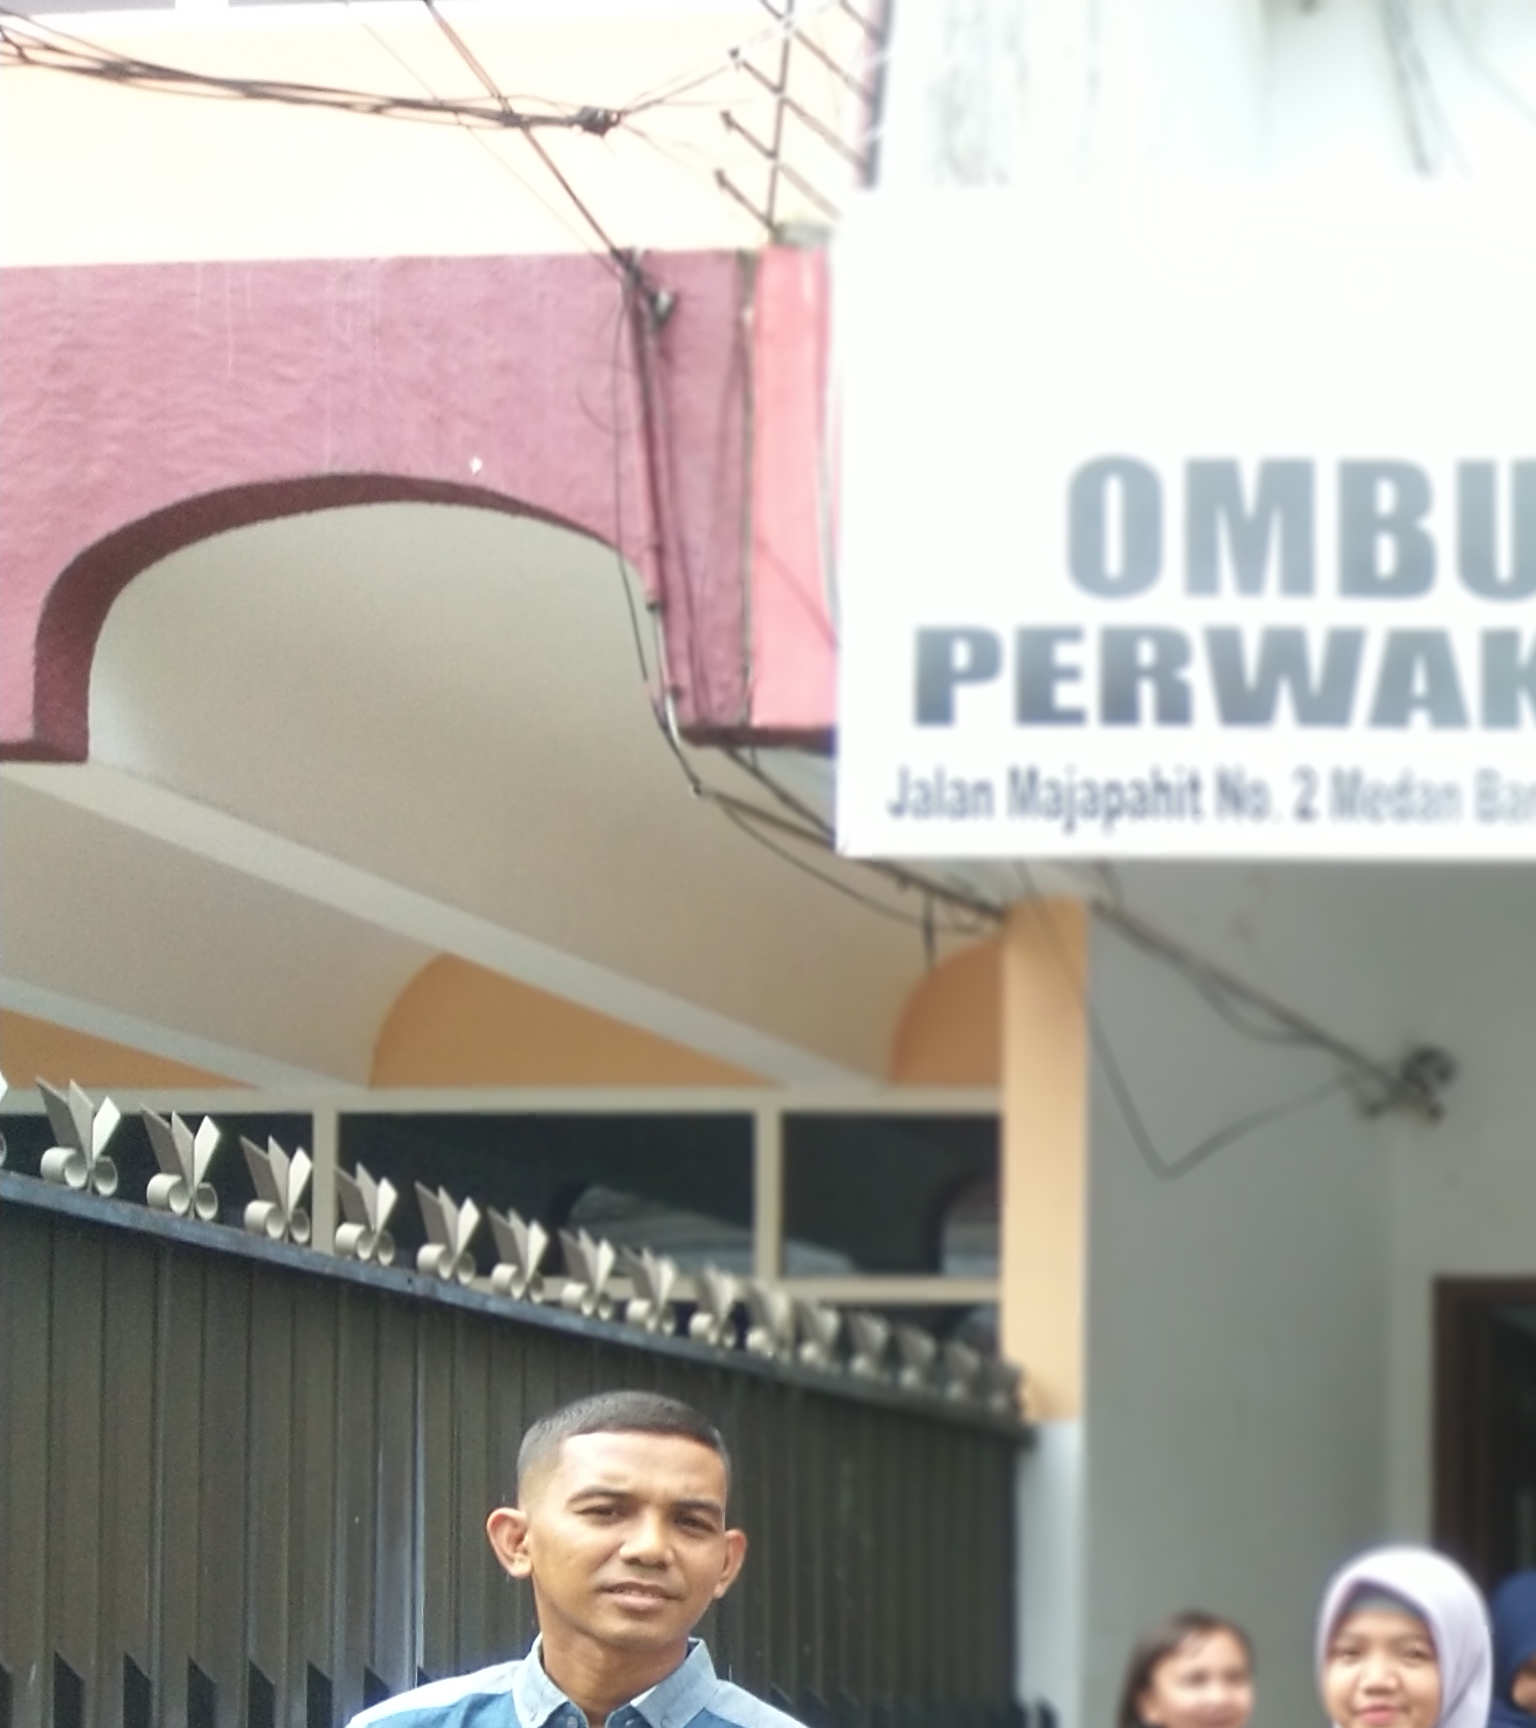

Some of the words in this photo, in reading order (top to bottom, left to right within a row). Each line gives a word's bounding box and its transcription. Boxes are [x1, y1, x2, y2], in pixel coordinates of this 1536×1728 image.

[886, 766, 994, 821] Jalan
[1007, 766, 1203, 835] Majapahit
[1293, 766, 1318, 822] 2
[1330, 766, 1459, 824] Medan
